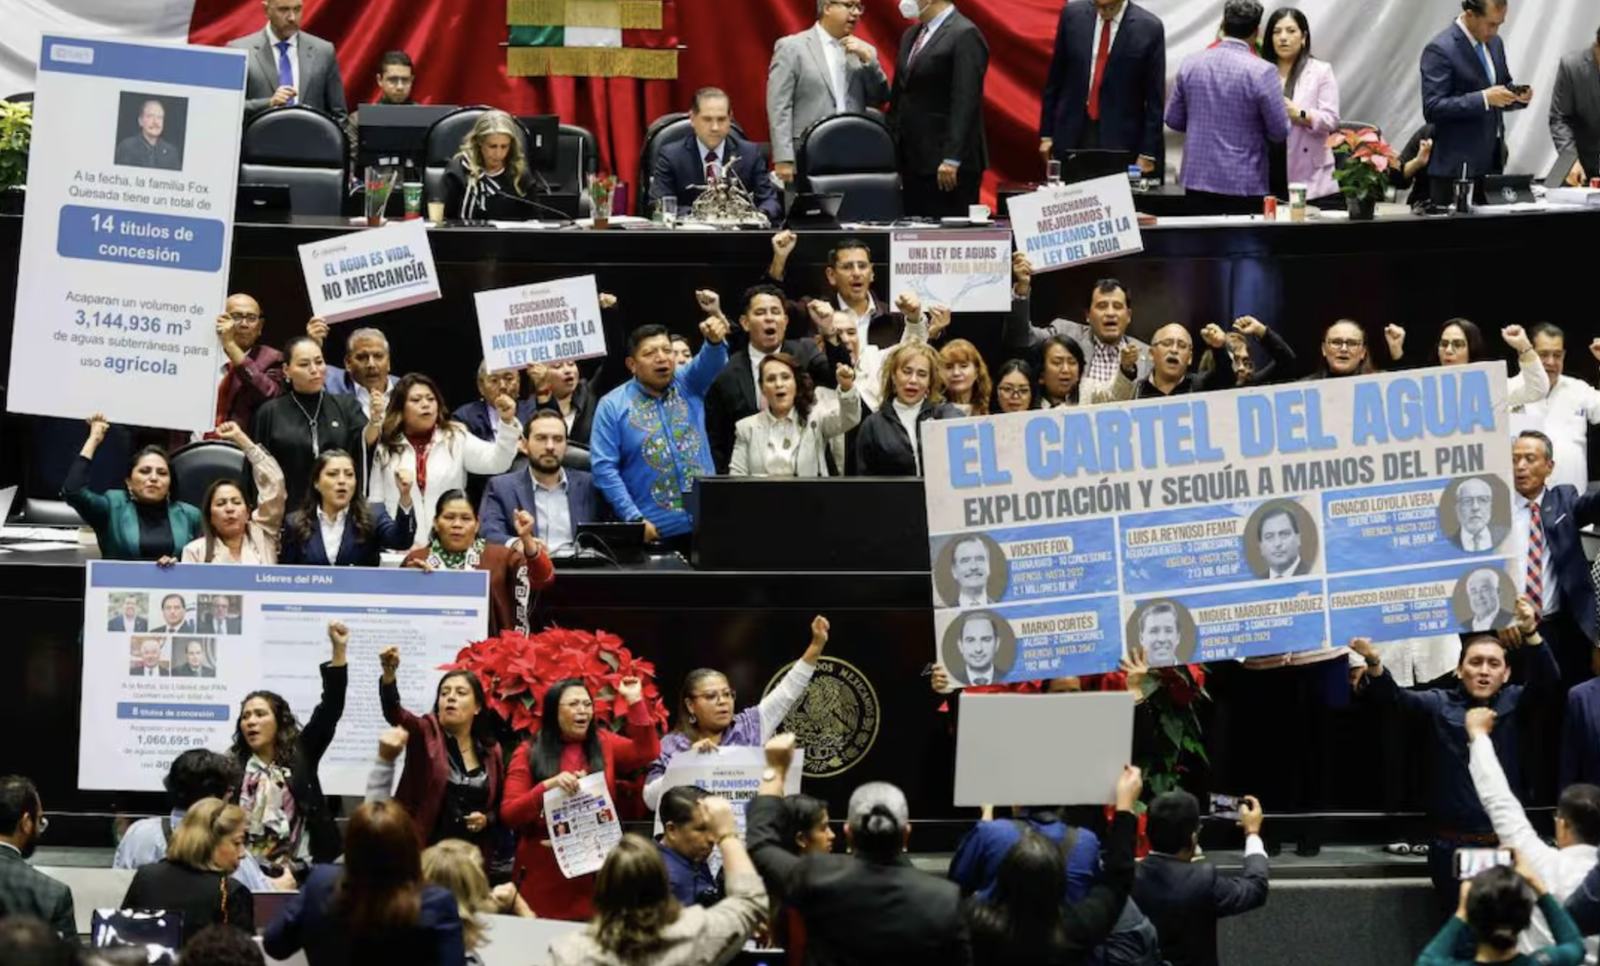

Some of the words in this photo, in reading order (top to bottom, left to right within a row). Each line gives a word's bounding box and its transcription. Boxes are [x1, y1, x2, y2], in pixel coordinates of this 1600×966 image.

[74, 170, 82, 181] A
[84, 172, 95, 182] la
[98, 172, 130, 186] fecha,
[135, 176, 145, 187] la
[148, 178, 185, 192] familia
[188, 182, 209, 194] Fox
[69, 185, 120, 201] Quesada
[123, 190, 150, 203] tiene
[152, 196, 168, 205] un
[170, 195, 194, 208] total
[196, 199, 212, 210] de
[1042, 195, 1102, 216] ESCUCHAMOS,
[91, 213, 114, 234] 14
[120, 218, 170, 240] títulos
[174, 226, 194, 242] de
[1037, 206, 1103, 233] MEJORAMOS
[1105, 204, 1112, 217] Y
[1026, 226, 1096, 252] AVANZAMOS
[1099, 222, 1114, 236] EN
[1116, 216, 1131, 232] LA
[98, 243, 180, 262] concesión
[324, 261, 338, 277] EL
[340, 254, 368, 274] AGUA
[370, 250, 384, 267] ES
[386, 244, 415, 264] VIDA,
[909, 248, 928, 259] UNA
[931, 248, 949, 259] LEY
[950, 247, 963, 259] DE
[965, 246, 996, 259] AGUAS
[1043, 250, 1063, 266] LEY
[1066, 244, 1087, 260] DEL
[1089, 237, 1120, 257] AGUA
[322, 282, 342, 301] NO
[344, 260, 428, 296] MERCANCÍA
[895, 262, 942, 275] MODERNA
[66, 291, 120, 307] Acaparan
[122, 297, 137, 308] un
[140, 299, 186, 314] volumen
[189, 303, 204, 316] de
[508, 296, 569, 315] ESCUCHAMOS,
[75, 309, 161, 334] 3,144,936
[504, 309, 568, 332] MEJORAMOS
[570, 307, 578, 320] Y
[53, 330, 68, 341] de
[70, 333, 104, 347] aguas
[108, 336, 181, 354] subterráneas
[183, 344, 210, 357] para
[492, 326, 562, 350] AVANZAMOS
[564, 324, 580, 338] EN
[581, 320, 596, 336] LA
[80, 356, 102, 368] uso
[104, 354, 178, 375] agrícola
[508, 349, 530, 365] LEY
[532, 345, 552, 360] DEL
[555, 340, 584, 358] AGUA
[946, 422, 1014, 490] EL
[1024, 400, 1225, 482] CARTEL
[1237, 388, 1338, 460] DEL
[1352, 369, 1497, 447] AGUA
[963, 477, 1131, 528] EXPLOTACIÓN
[1137, 479, 1154, 508] Y
[1161, 464, 1250, 505] SEQUÍA
[1258, 466, 1275, 495] A
[1282, 456, 1375, 493] MANOS
[1383, 450, 1428, 480] DEL
[1435, 444, 1484, 476] PAN
[1330, 499, 1370, 516] IGNACIO
[1371, 496, 1408, 512] LOYOLA
[1408, 492, 1435, 506] VERA
[1128, 530, 1150, 546] LUIS
[1159, 524, 1204, 542] REYNOSO
[1206, 520, 1238, 537] FEMAT
[1010, 542, 1049, 558] VICENTE
[1051, 539, 1070, 552] FOX
[255, 573, 292, 584] Líderes
[294, 574, 310, 584] del
[312, 575, 334, 584] PAN
[1332, 592, 1378, 608] FRANCISCO
[1021, 620, 1056, 635] MARKO
[1057, 616, 1094, 632] CORTÉS
[1199, 608, 1232, 624] MIGUEL
[711, 779, 760, 789] PANISMO
